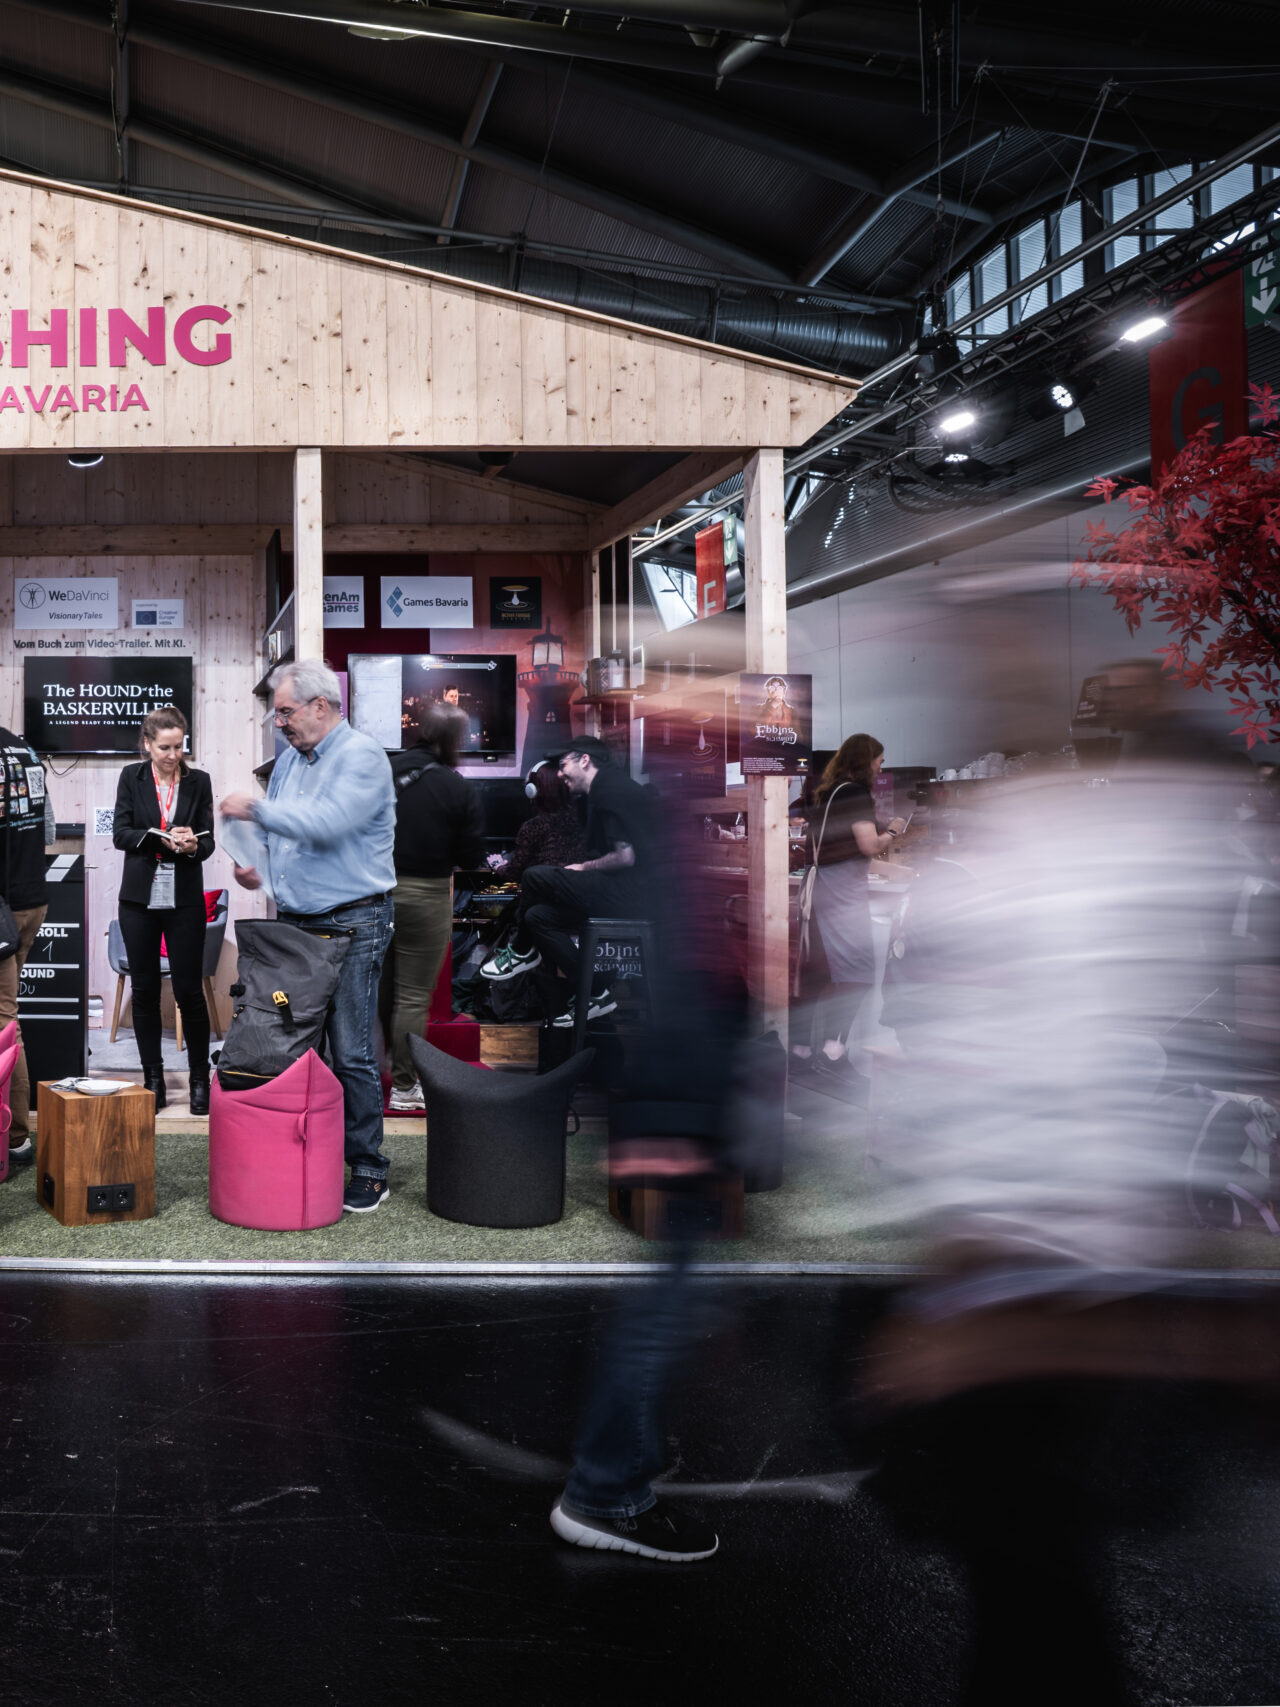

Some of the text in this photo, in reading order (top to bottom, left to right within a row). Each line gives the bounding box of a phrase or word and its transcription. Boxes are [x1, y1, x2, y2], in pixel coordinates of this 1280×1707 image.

[1172, 366, 1223, 452] G
[49, 590, 109, 601] WeDaVinci
[323, 591, 360, 602] enAm
[403, 597, 468, 607] Games Bavaria
[14, 639, 35, 648] Vom
[38, 639, 62, 648] Buch
[87, 639, 152, 648] Video-Trailer.
[154, 639, 171, 648] Mit
[173, 639, 186, 648] KI.
[43, 684, 75, 697] The
[79, 684, 141, 697] HOUND
[148, 684, 173, 697] the
[755, 725, 797, 745] Ebbing
[36, 927, 68, 937] ROLL
[42, 940, 53, 961] 1
[20, 968, 55, 978] OUND
[19, 981, 35, 995] Du
